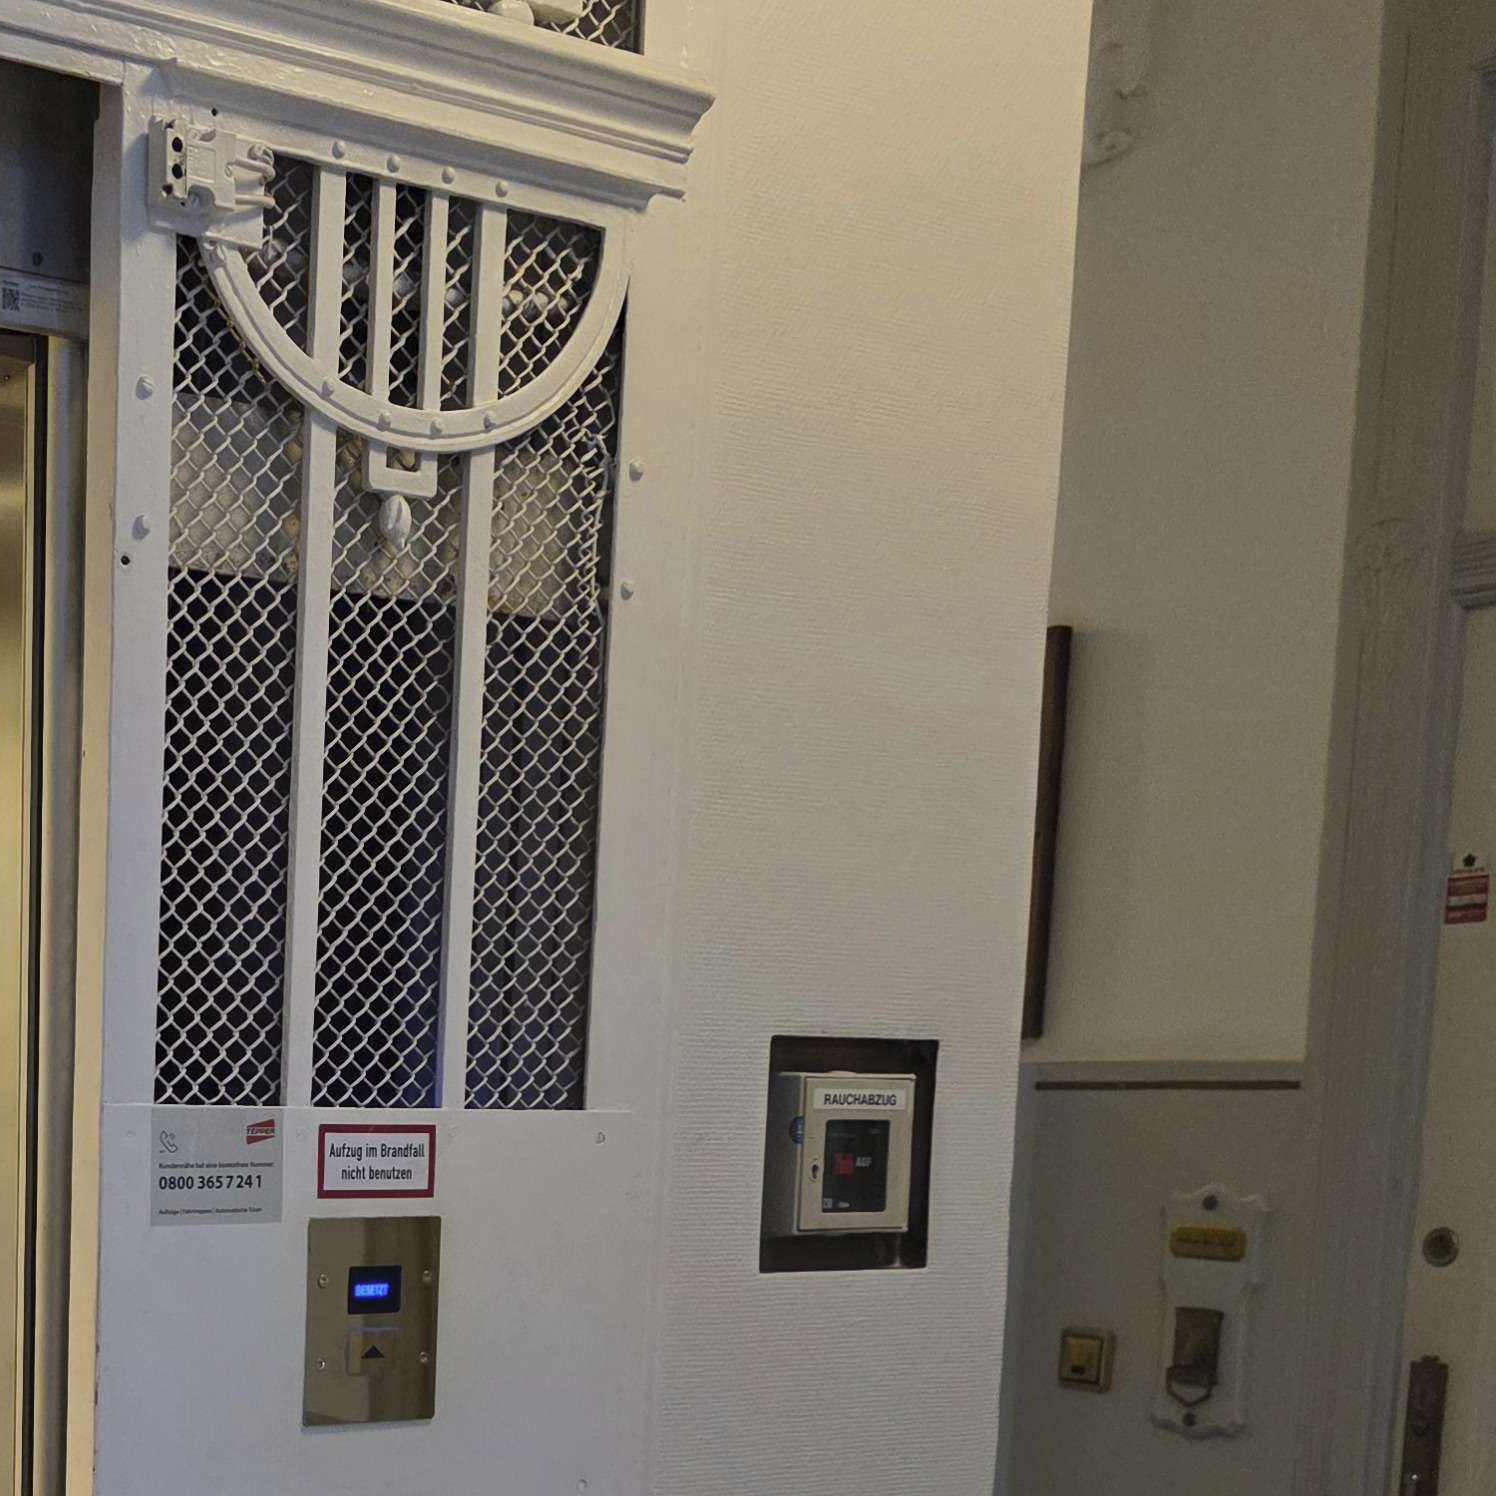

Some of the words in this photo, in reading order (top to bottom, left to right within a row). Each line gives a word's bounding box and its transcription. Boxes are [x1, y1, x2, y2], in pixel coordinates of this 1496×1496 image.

[823, 1093, 897, 1106] RAUCHABZUG
[329, 1143, 363, 1161] Aufzug
[365, 1143, 378, 1158] im
[380, 1143, 425, 1158] Brandfall
[341, 1166, 365, 1180] nicht
[368, 1166, 413, 1180] benutzen
[158, 1176, 194, 1190] 0800
